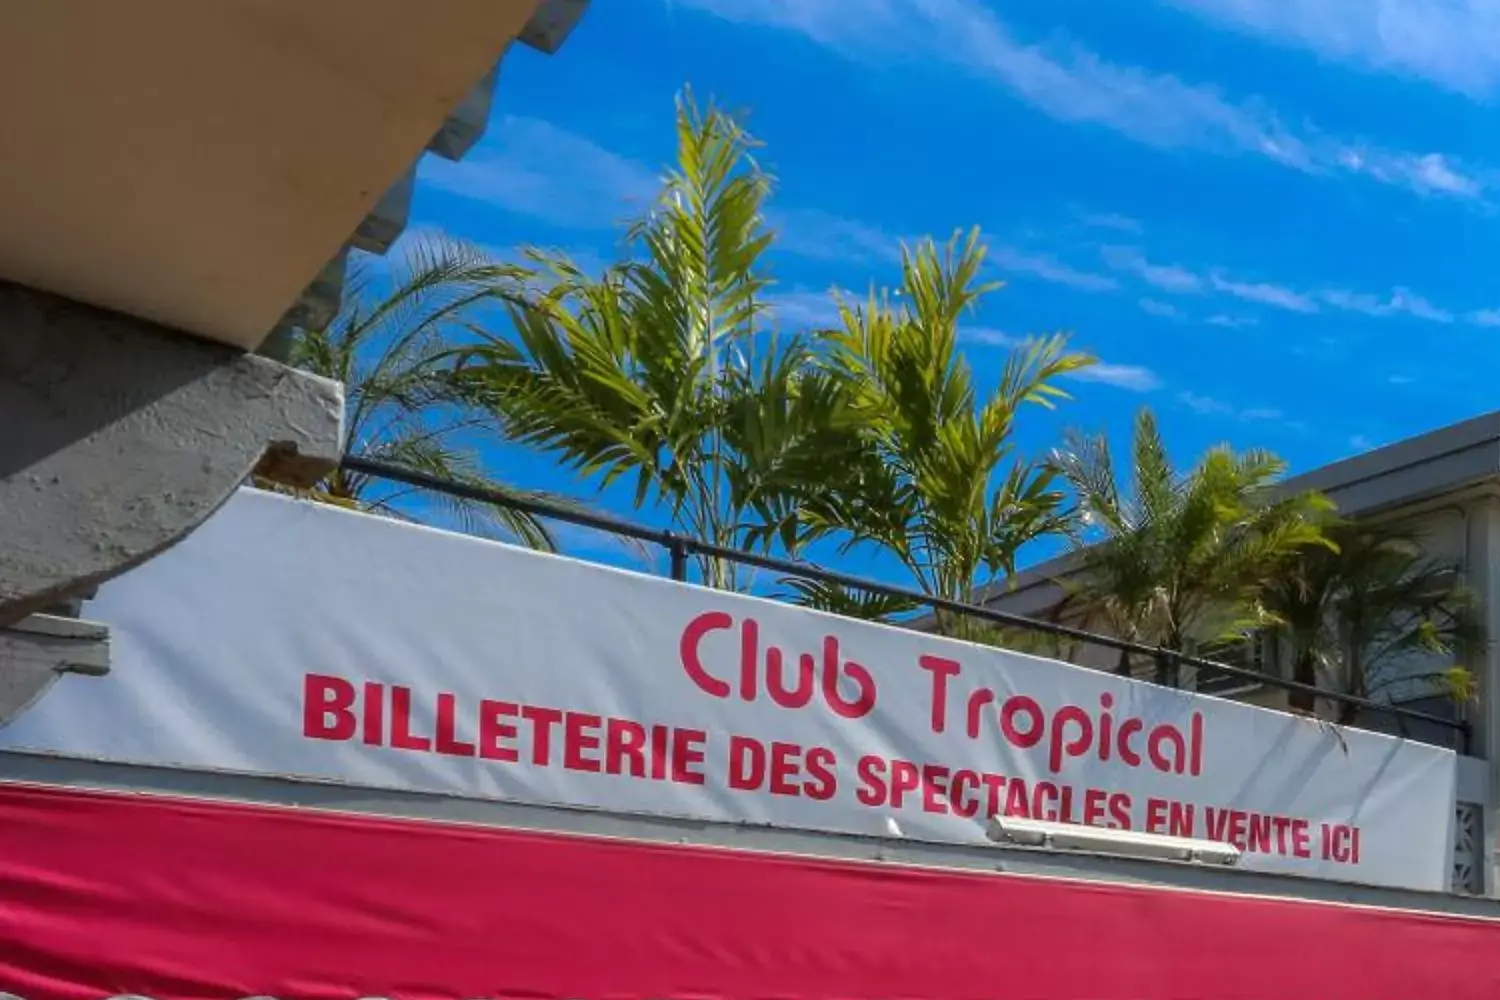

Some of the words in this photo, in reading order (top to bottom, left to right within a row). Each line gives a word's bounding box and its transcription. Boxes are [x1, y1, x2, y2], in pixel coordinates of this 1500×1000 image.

[303, 673, 706, 785] BILLETERIE
[728, 735, 838, 801] DES
[856, 755, 1132, 831] SPECTACLES
[1146, 797, 1195, 839] EN
[1205, 807, 1312, 859] VENTE
[1320, 824, 1361, 865] ICI
[679, 610, 877, 719] Club
[918, 655, 1203, 776] Tropical
